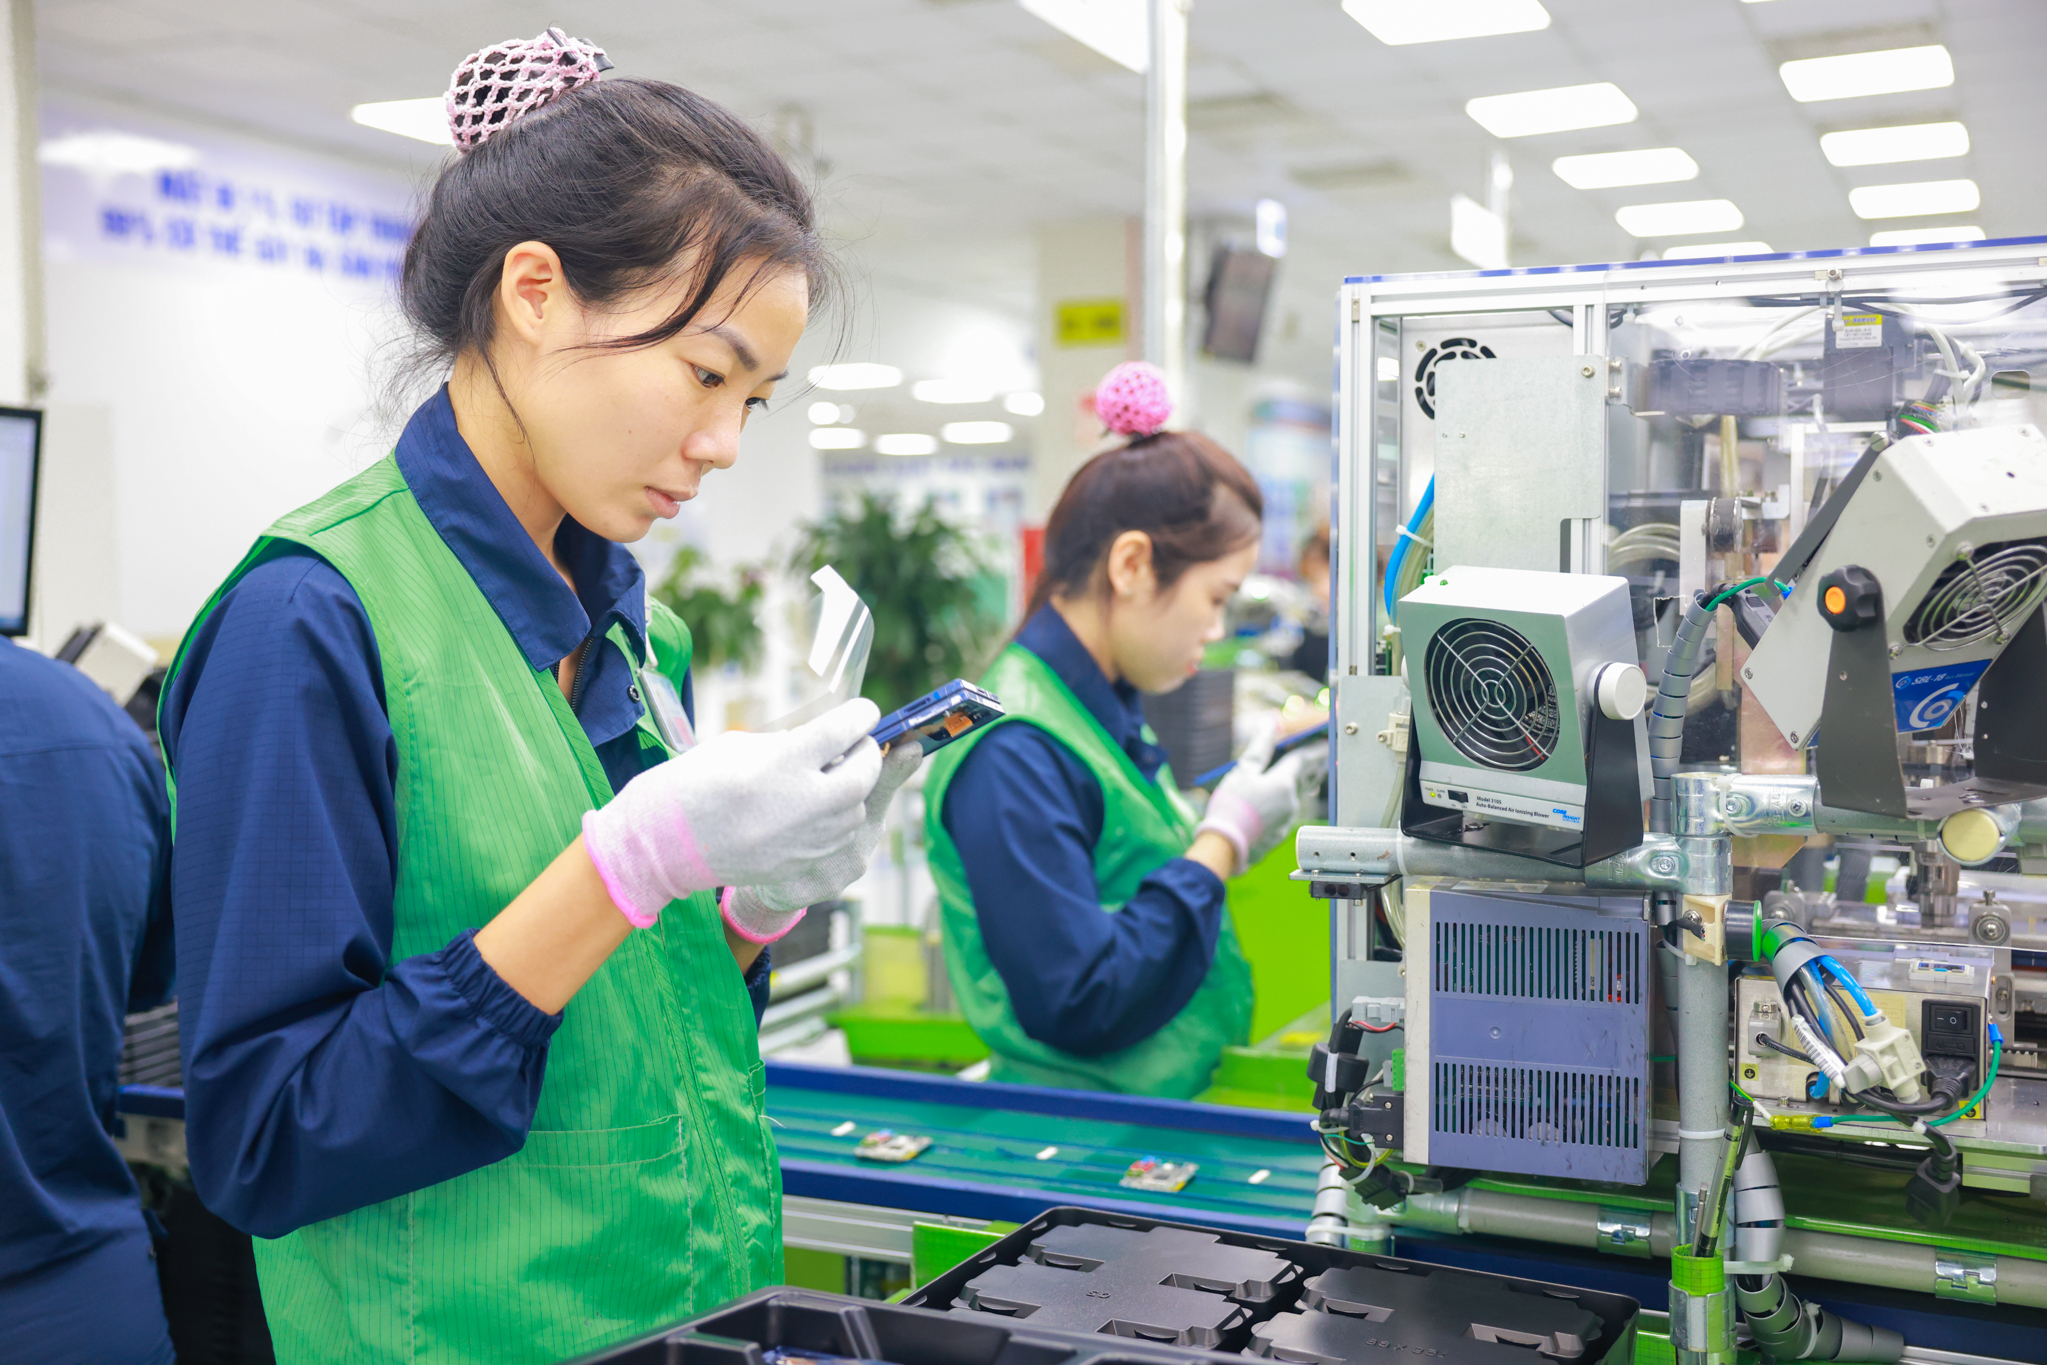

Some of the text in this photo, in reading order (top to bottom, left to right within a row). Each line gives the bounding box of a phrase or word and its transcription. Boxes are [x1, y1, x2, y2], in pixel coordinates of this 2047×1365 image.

[1911, 673, 1947, 685] SBL-18
[1476, 802, 1507, 811] Auto-Balanced
[1515, 808, 1533, 817] Ionizing
